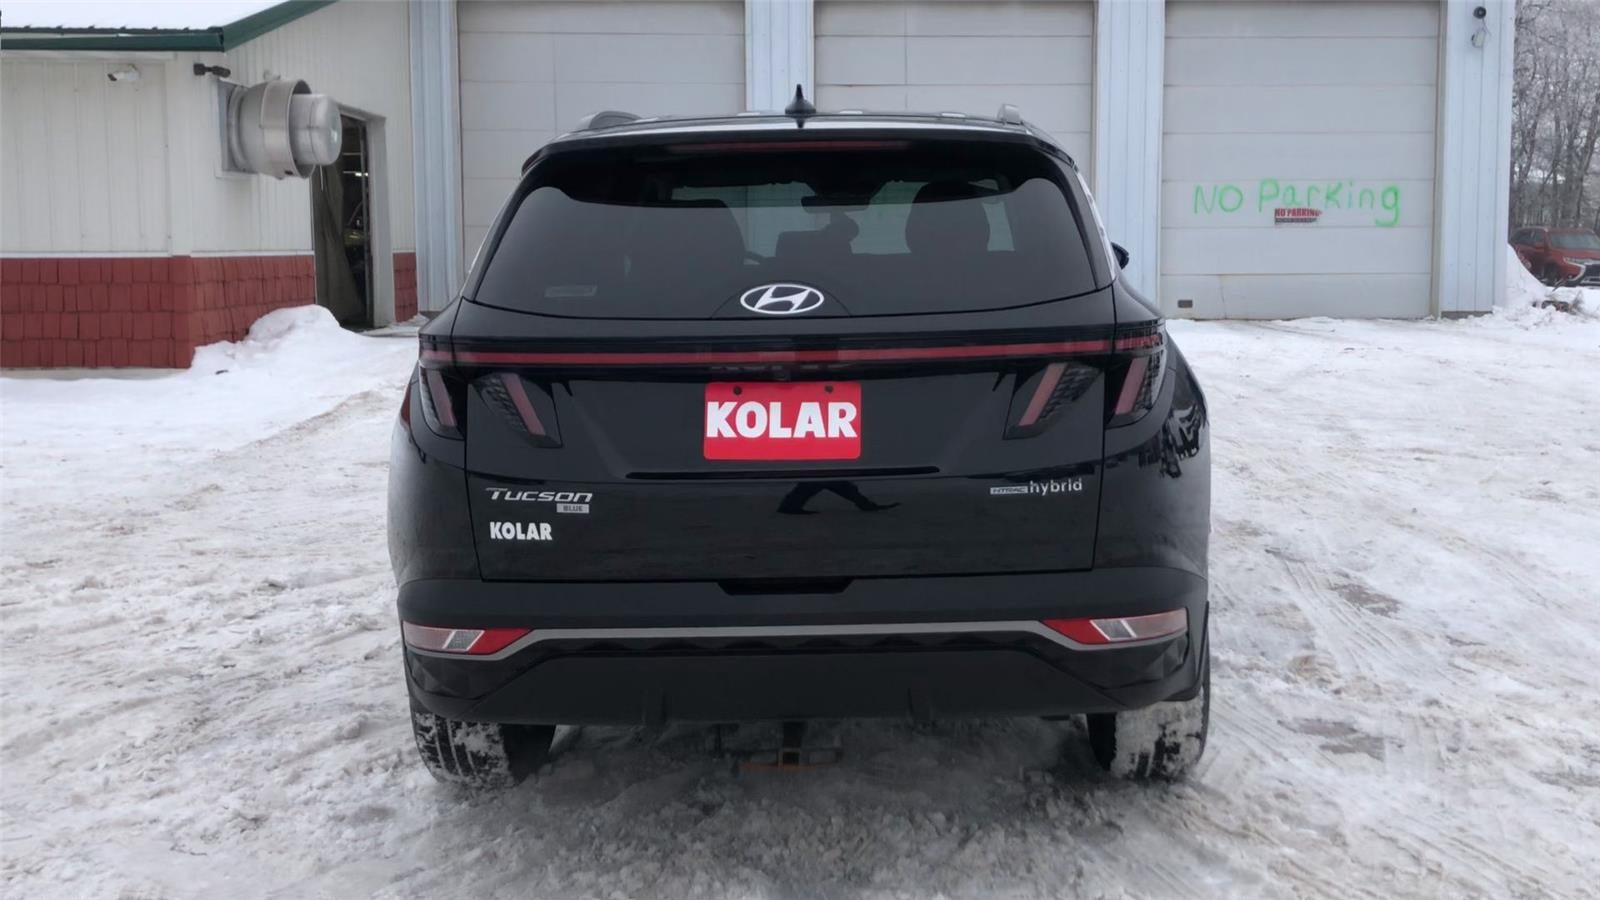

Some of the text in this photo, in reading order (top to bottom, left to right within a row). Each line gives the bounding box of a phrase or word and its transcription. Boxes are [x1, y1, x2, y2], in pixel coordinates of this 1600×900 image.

[1274, 208, 1286, 217] NO
[706, 401, 858, 438] KOLAR
[1030, 478, 1082, 496] hybrid
[490, 521, 553, 540] KOLAR
